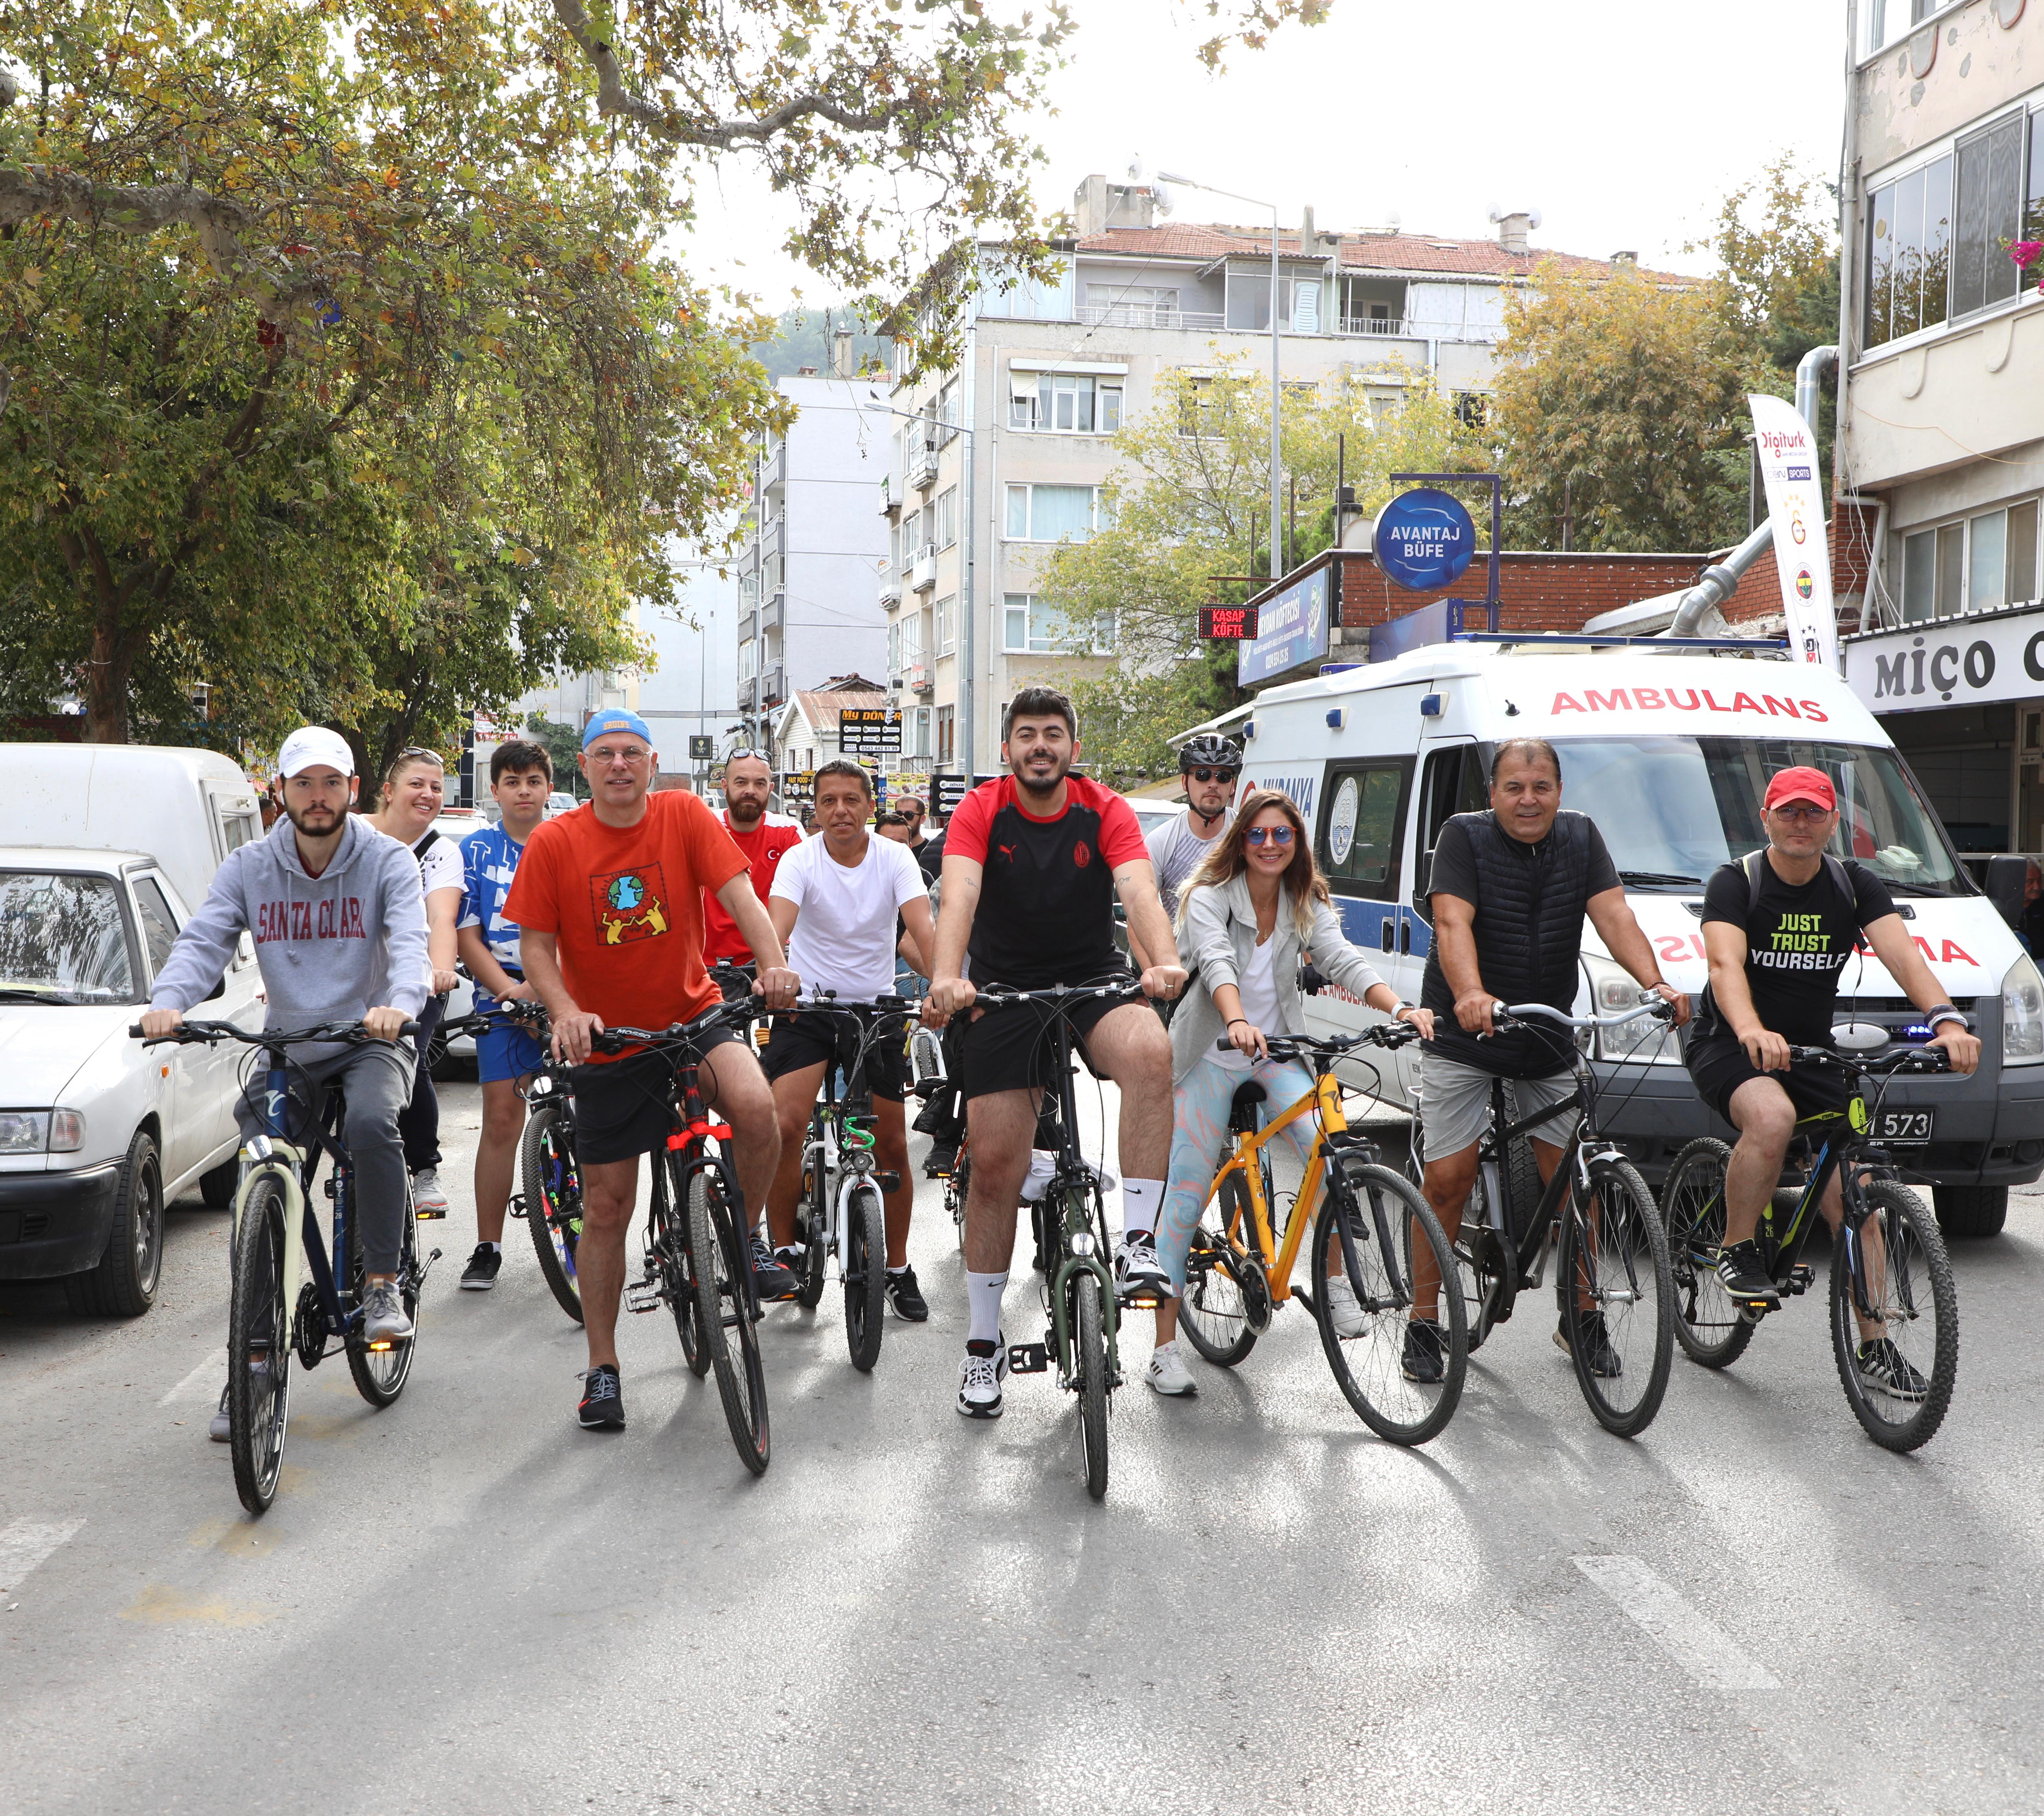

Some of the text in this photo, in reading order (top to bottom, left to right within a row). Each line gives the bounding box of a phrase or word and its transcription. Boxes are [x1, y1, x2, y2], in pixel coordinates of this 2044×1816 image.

[1789, 469, 1809, 478] SPORTS
[1391, 527, 1459, 540] AVANTAJ
[1404, 541, 1444, 557] BÜFE
[1212, 610, 1245, 622] KASAP
[1257, 610, 1275, 639] MEYDAN
[1276, 590, 1300, 630] KÖFTECİSİ
[1213, 622, 1243, 636] KÖFTE
[1875, 637, 1995, 701] MİÇO
[1551, 688, 1828, 722] AMBULANS
[842, 710, 859, 720] My
[603, 720, 629, 730] BRUINS
[257, 901, 311, 944] SANTA
[1778, 914, 1821, 932] JUST
[1771, 933, 1830, 951] TRUST
[1751, 949, 1846, 969] YOURSELF
[706, 1009, 722, 1021] MOSSO
[617, 1028, 651, 1039] MOSSO
[1885, 1114, 1928, 1135] 573
[1765, 1227, 1774, 1237] 26
